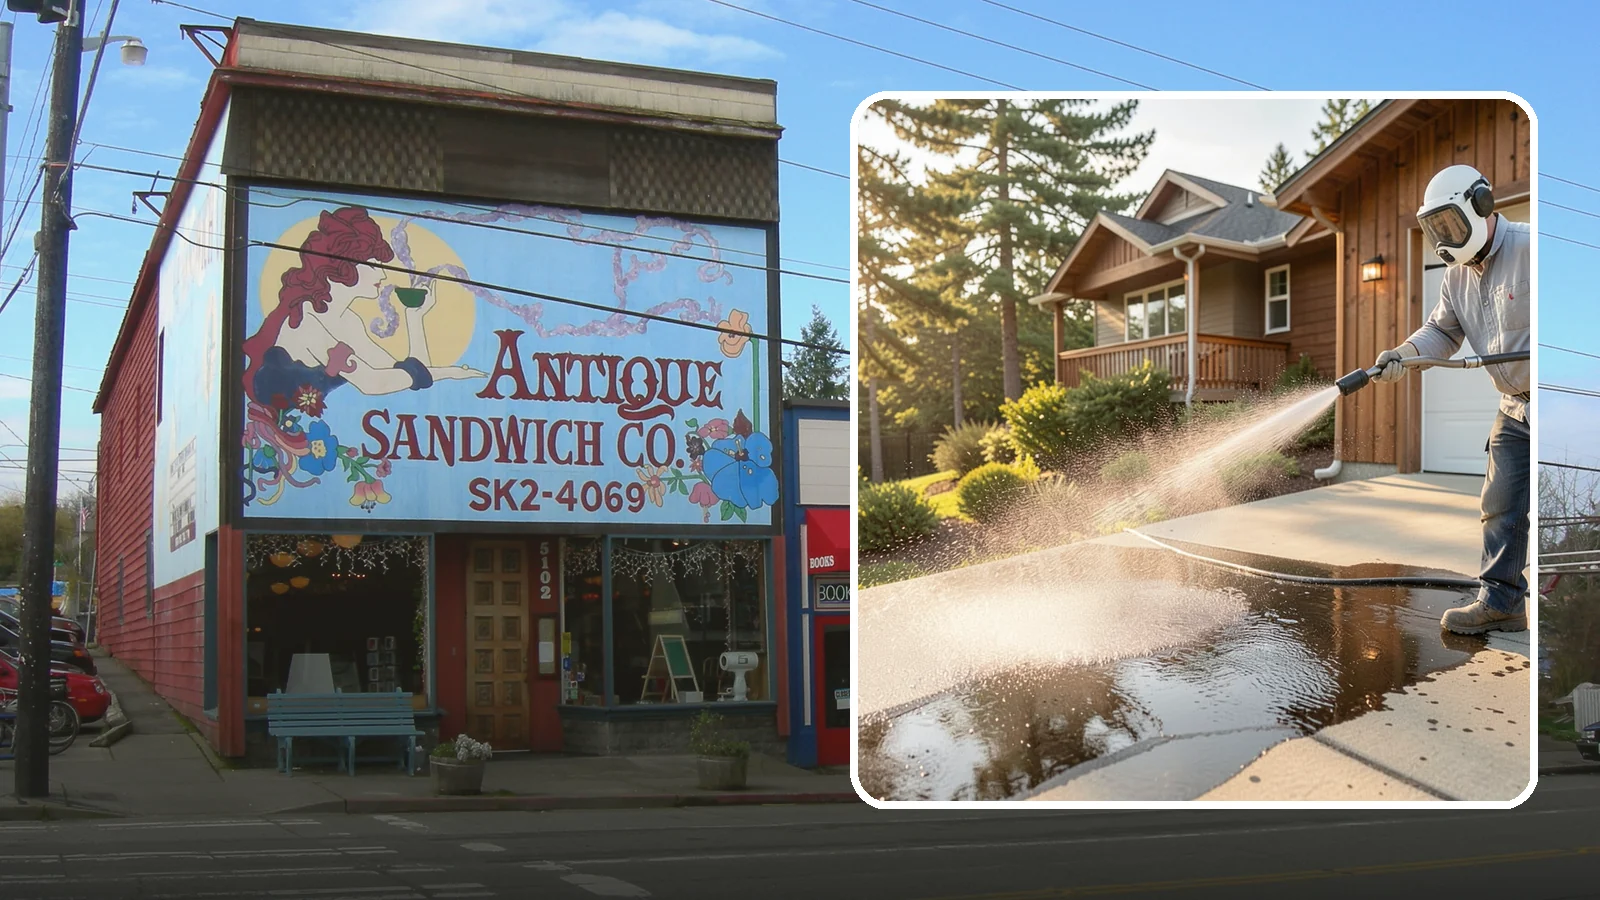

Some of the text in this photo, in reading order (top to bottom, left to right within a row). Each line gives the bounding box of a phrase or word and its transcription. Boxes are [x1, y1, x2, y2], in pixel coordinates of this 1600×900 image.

[476, 330, 724, 421] ANTIQUE
[361, 408, 685, 468] SANDWICH CO.
[469, 477, 645, 513] SK2-4069
[540, 541, 551, 600] 5102
[809, 555, 835, 569] BOOKS
